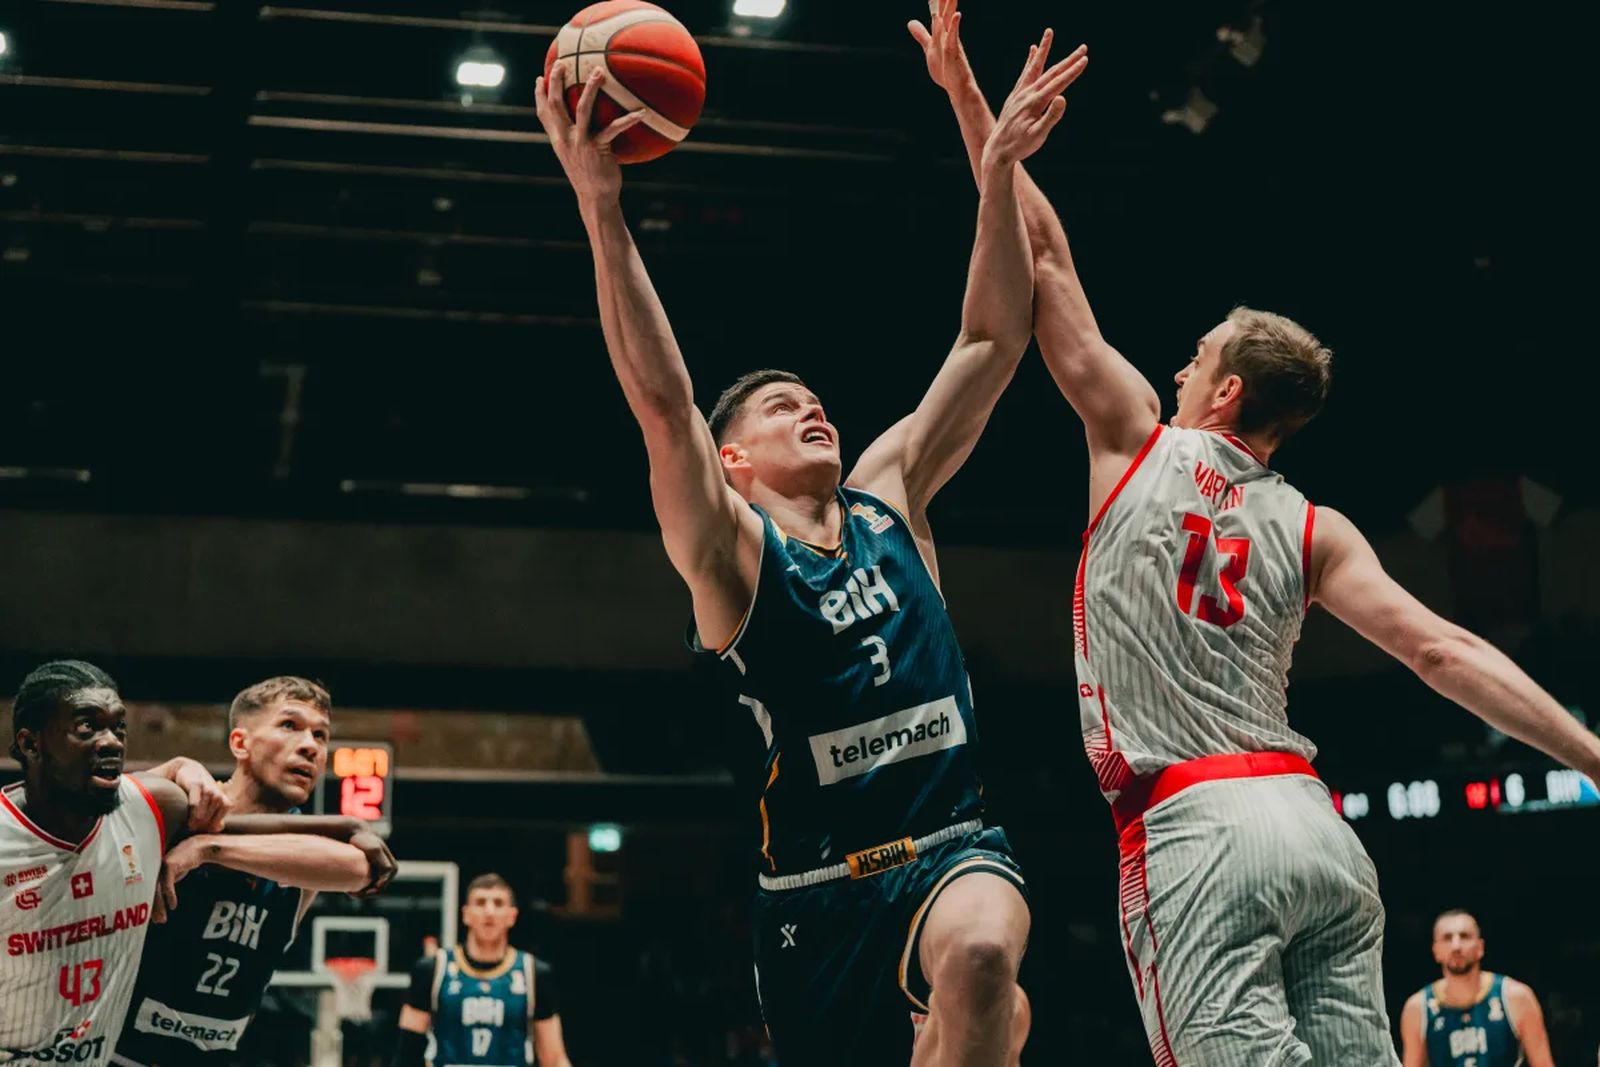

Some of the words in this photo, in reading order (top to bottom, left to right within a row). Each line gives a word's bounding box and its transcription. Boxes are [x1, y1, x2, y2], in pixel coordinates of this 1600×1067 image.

[1176, 511, 1251, 628] 13
[862, 635, 891, 687] 3
[829, 712, 950, 768] telemach
[341, 776, 384, 820] 12
[856, 841, 910, 876] HSBIH
[7, 902, 149, 957] SWITZERLAND
[59, 959, 104, 1007] 43
[195, 952, 240, 997] 22
